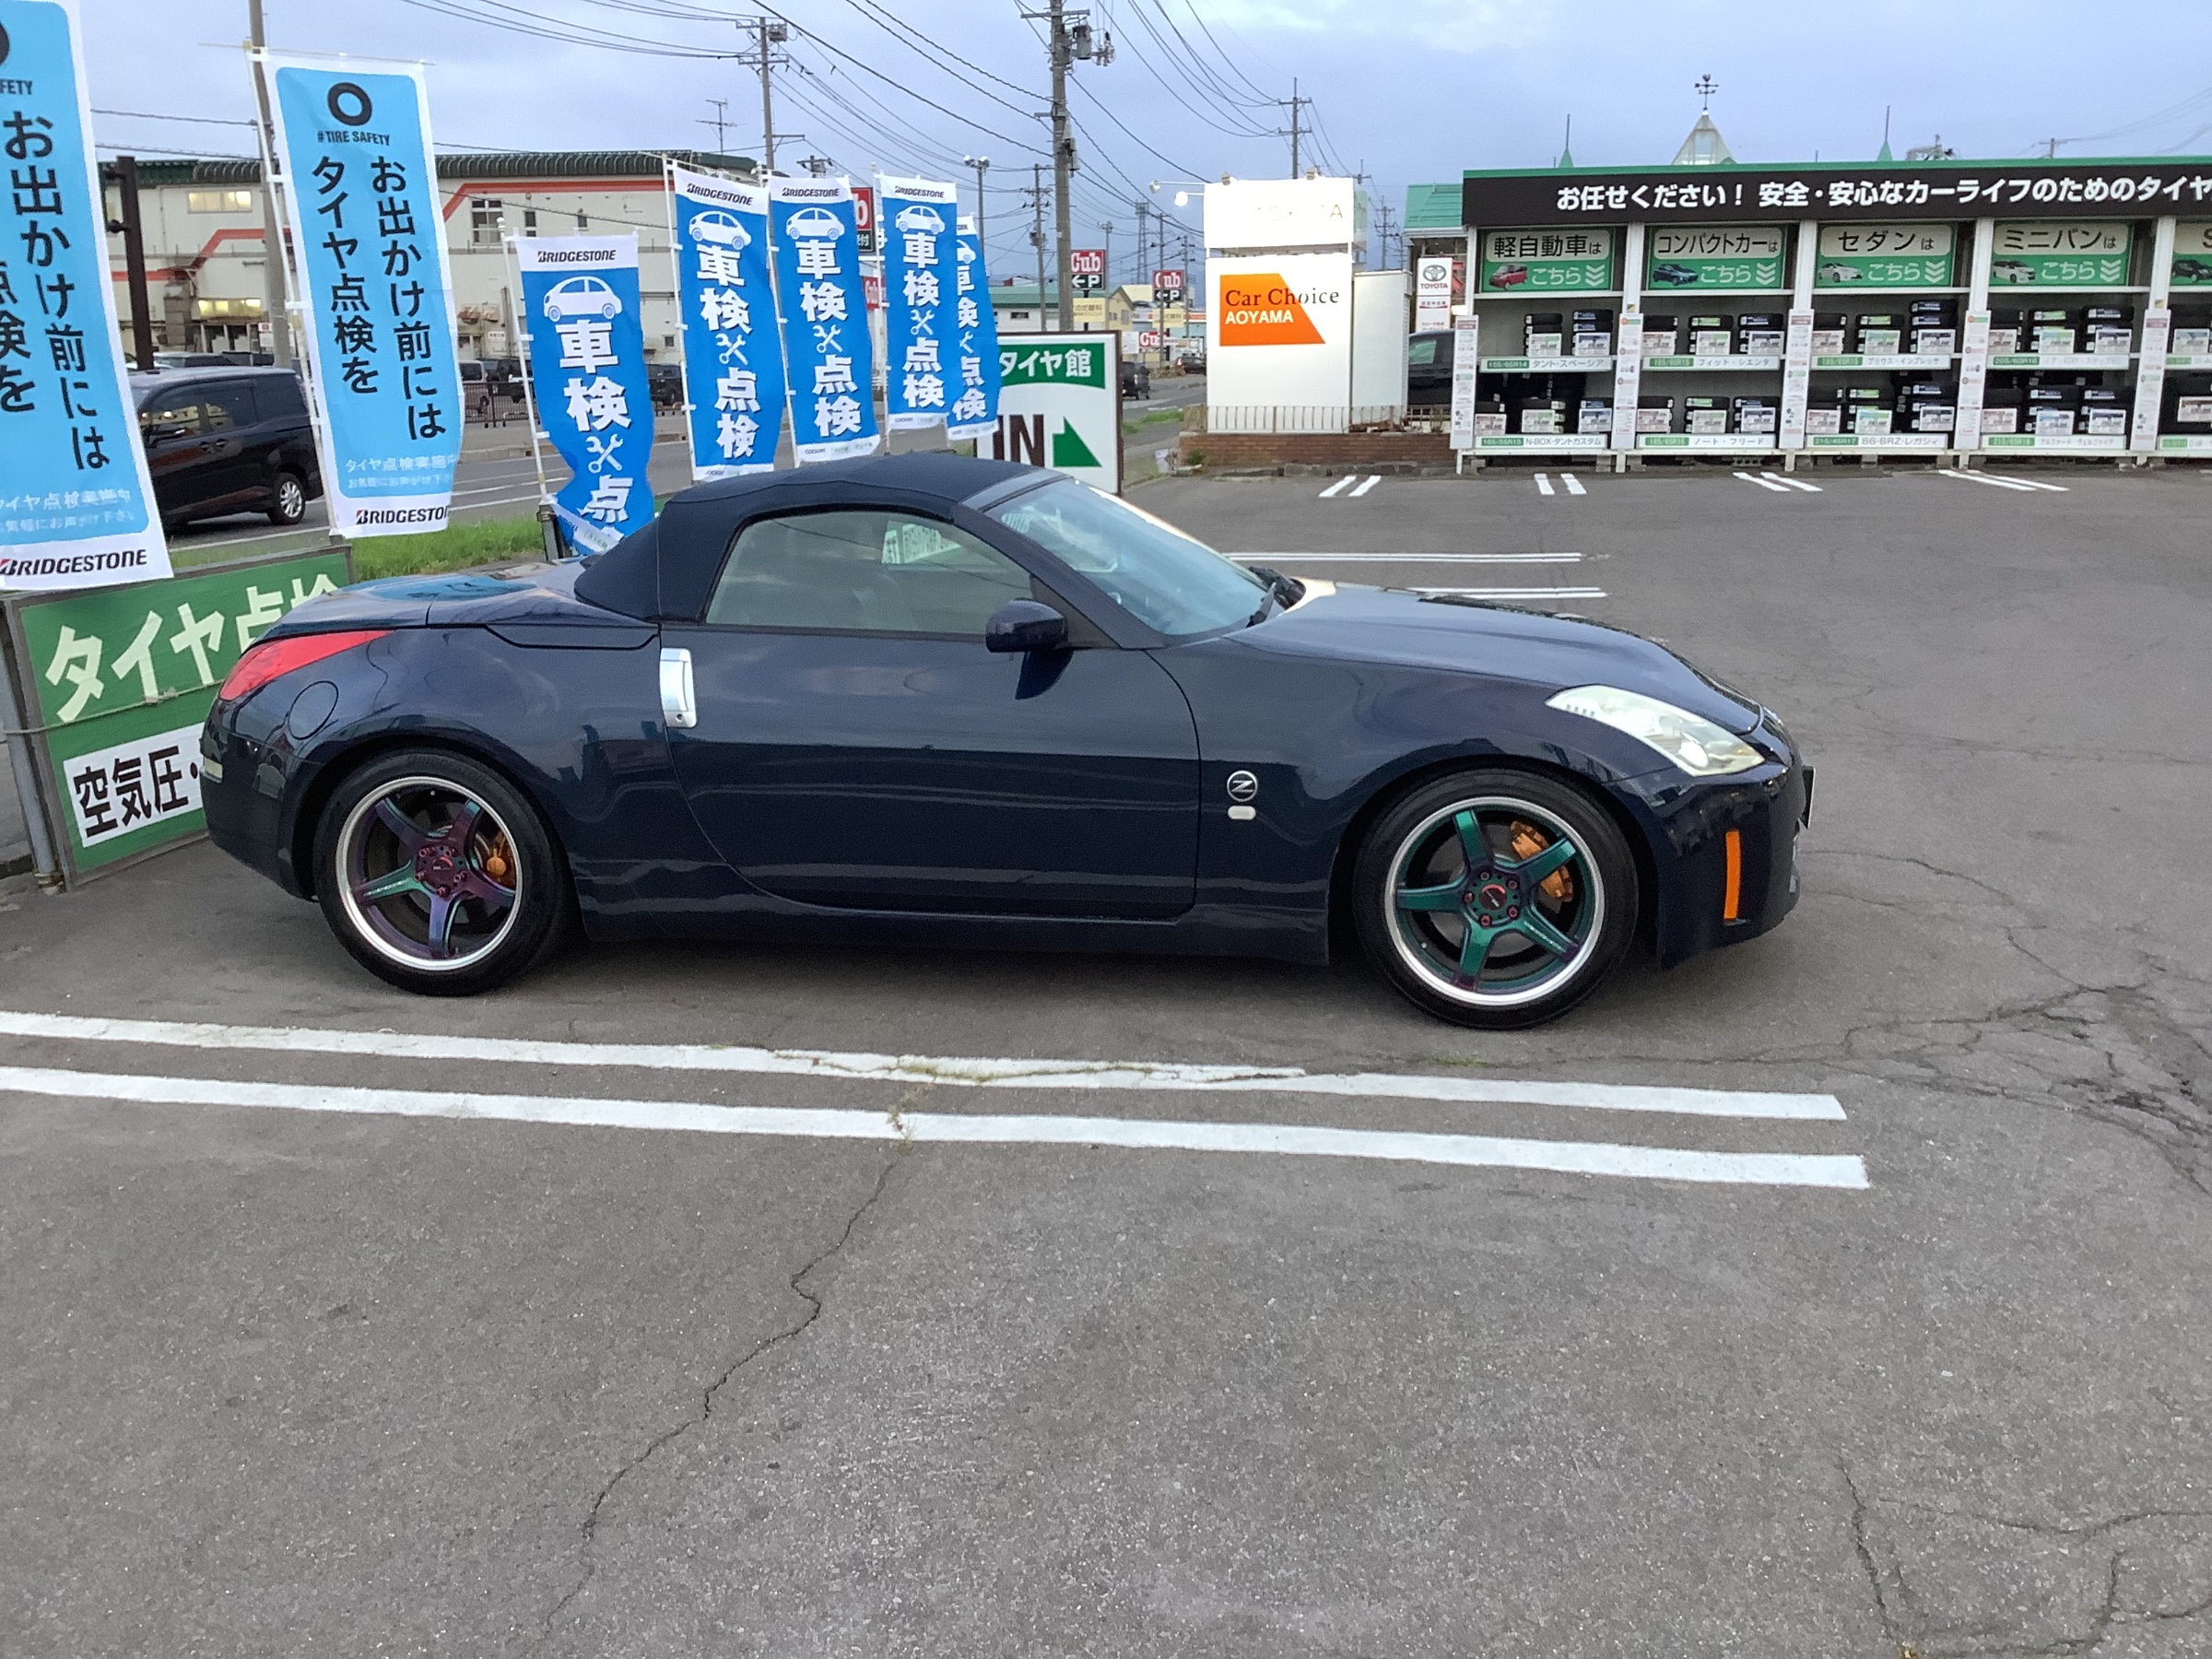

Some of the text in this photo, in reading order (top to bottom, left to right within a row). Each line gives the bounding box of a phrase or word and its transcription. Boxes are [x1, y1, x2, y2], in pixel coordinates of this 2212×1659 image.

[0, 78, 32, 95] FETY
[317, 131, 390, 147] #TIRE SAFETY
[685, 183, 754, 206] BRIDGESTONE
[782, 187, 840, 197] BRIDGESTONE
[895, 186, 945, 198] BRIDGESTONE
[1493, 234, 1602, 259] 軽自動車は
[1657, 232, 1779, 254] コンパクトカーは
[1837, 229, 1936, 253] セダンは
[2004, 228, 2117, 251] ミニバンは
[537, 250, 617, 263] BRIDGESTONE
[1071, 253, 1101, 273] Cub
[312, 156, 379, 395] タイヤ点検を
[1530, 267, 1582, 286] こちら
[1700, 265, 1751, 284] こちら
[1867, 262, 1921, 282] こちら
[2041, 260, 2096, 280] こちら
[4, 110, 111, 471] お出かけ前には
[370, 156, 446, 441] お出かけ前には
[1225, 287, 1340, 306] Car Choice
[902, 232, 946, 409] 車検 点検
[1225, 310, 1294, 324] AOYAMA
[794, 240, 862, 437] 車検 点検
[696, 244, 761, 459] 車検 点検
[999, 348, 1091, 377] タイヤ館
[555, 320, 632, 431] 車検
[0, 549, 147, 576] BRIDGESTONE
